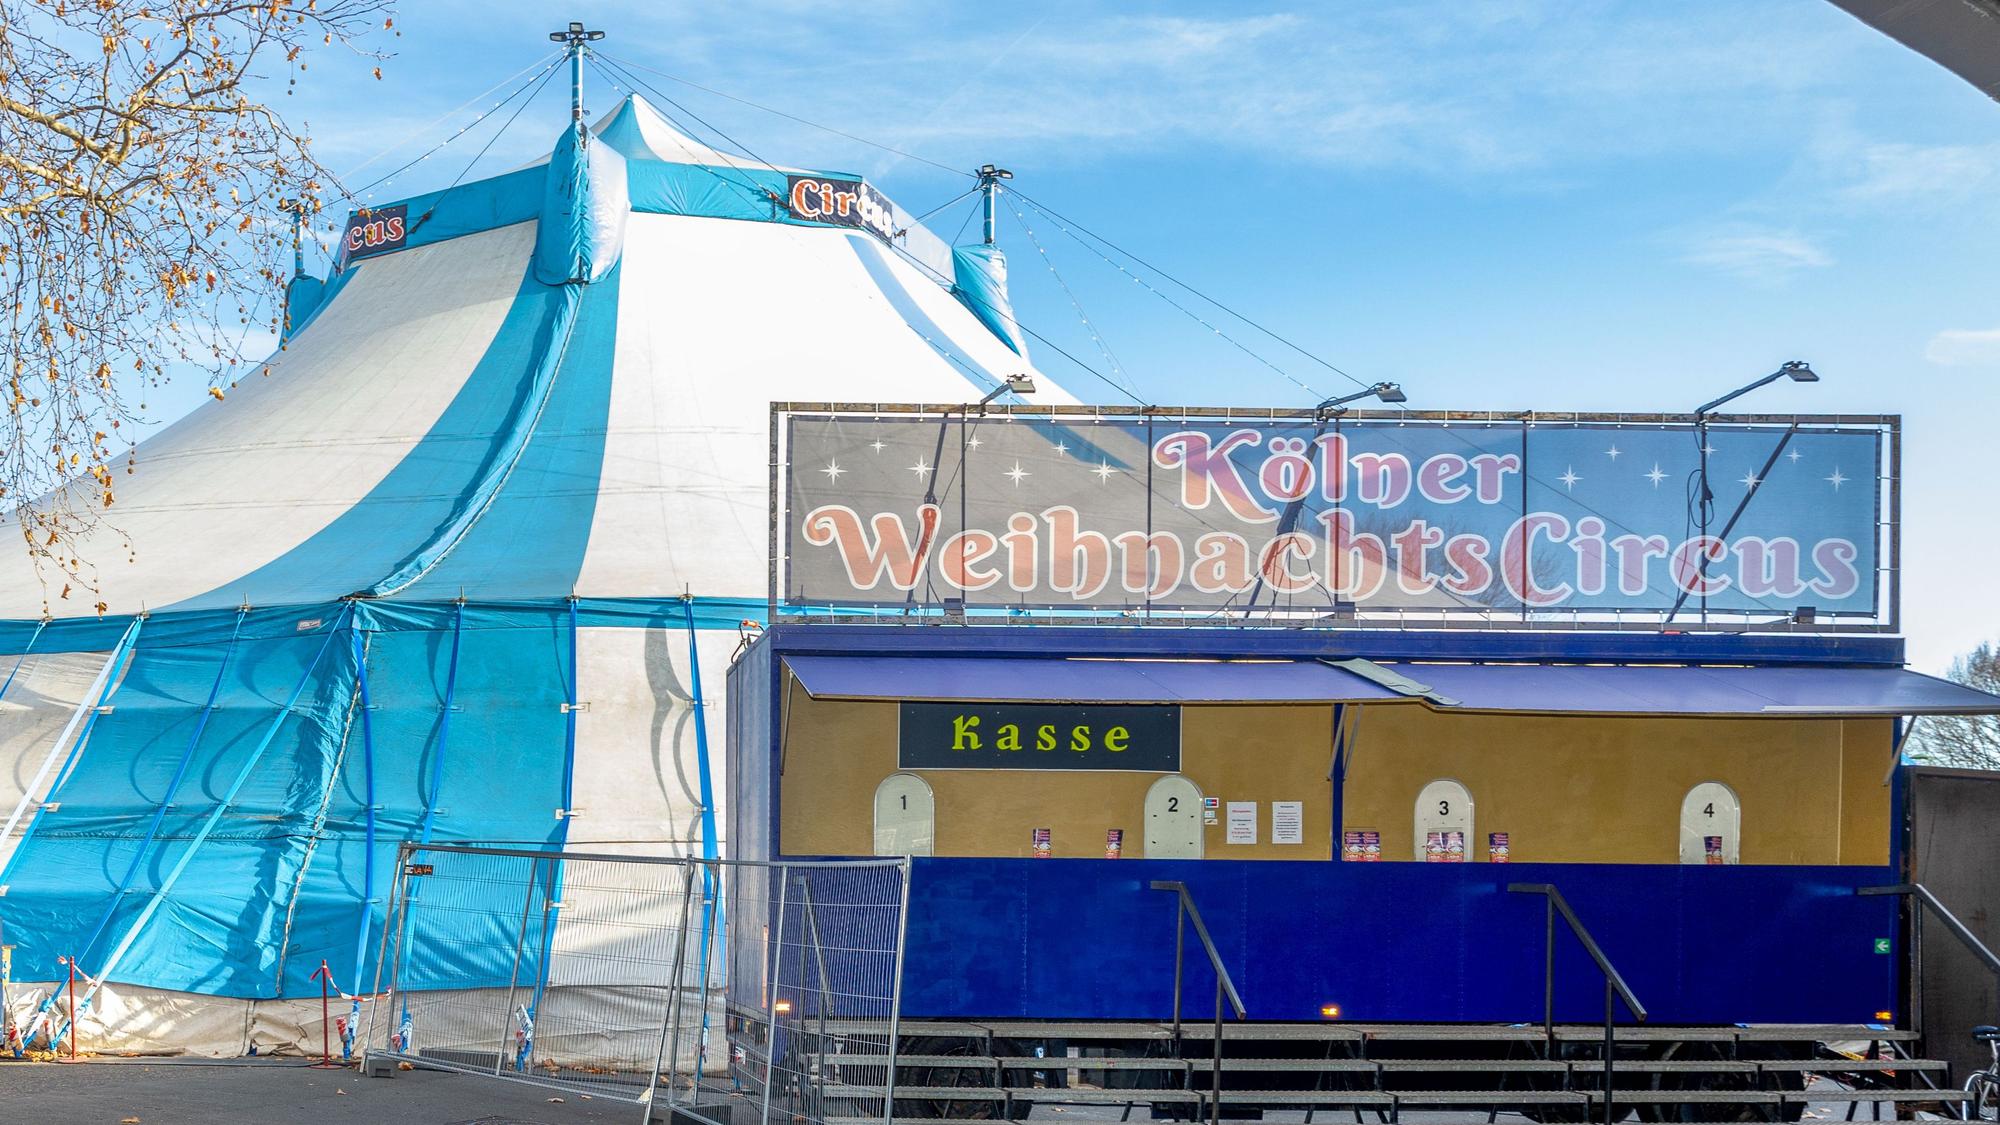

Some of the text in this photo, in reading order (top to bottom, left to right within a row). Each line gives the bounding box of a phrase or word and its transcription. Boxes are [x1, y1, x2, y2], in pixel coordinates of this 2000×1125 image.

[1152, 429, 1521, 524] Kölner
[803, 504, 1860, 606] WeihnachtsCircus
[952, 714, 1131, 752] Kasse
[900, 794, 907, 810] 1
[1168, 797, 1179, 812] 2
[1439, 800, 1449, 816] 3
[1703, 802, 1715, 818] 4
